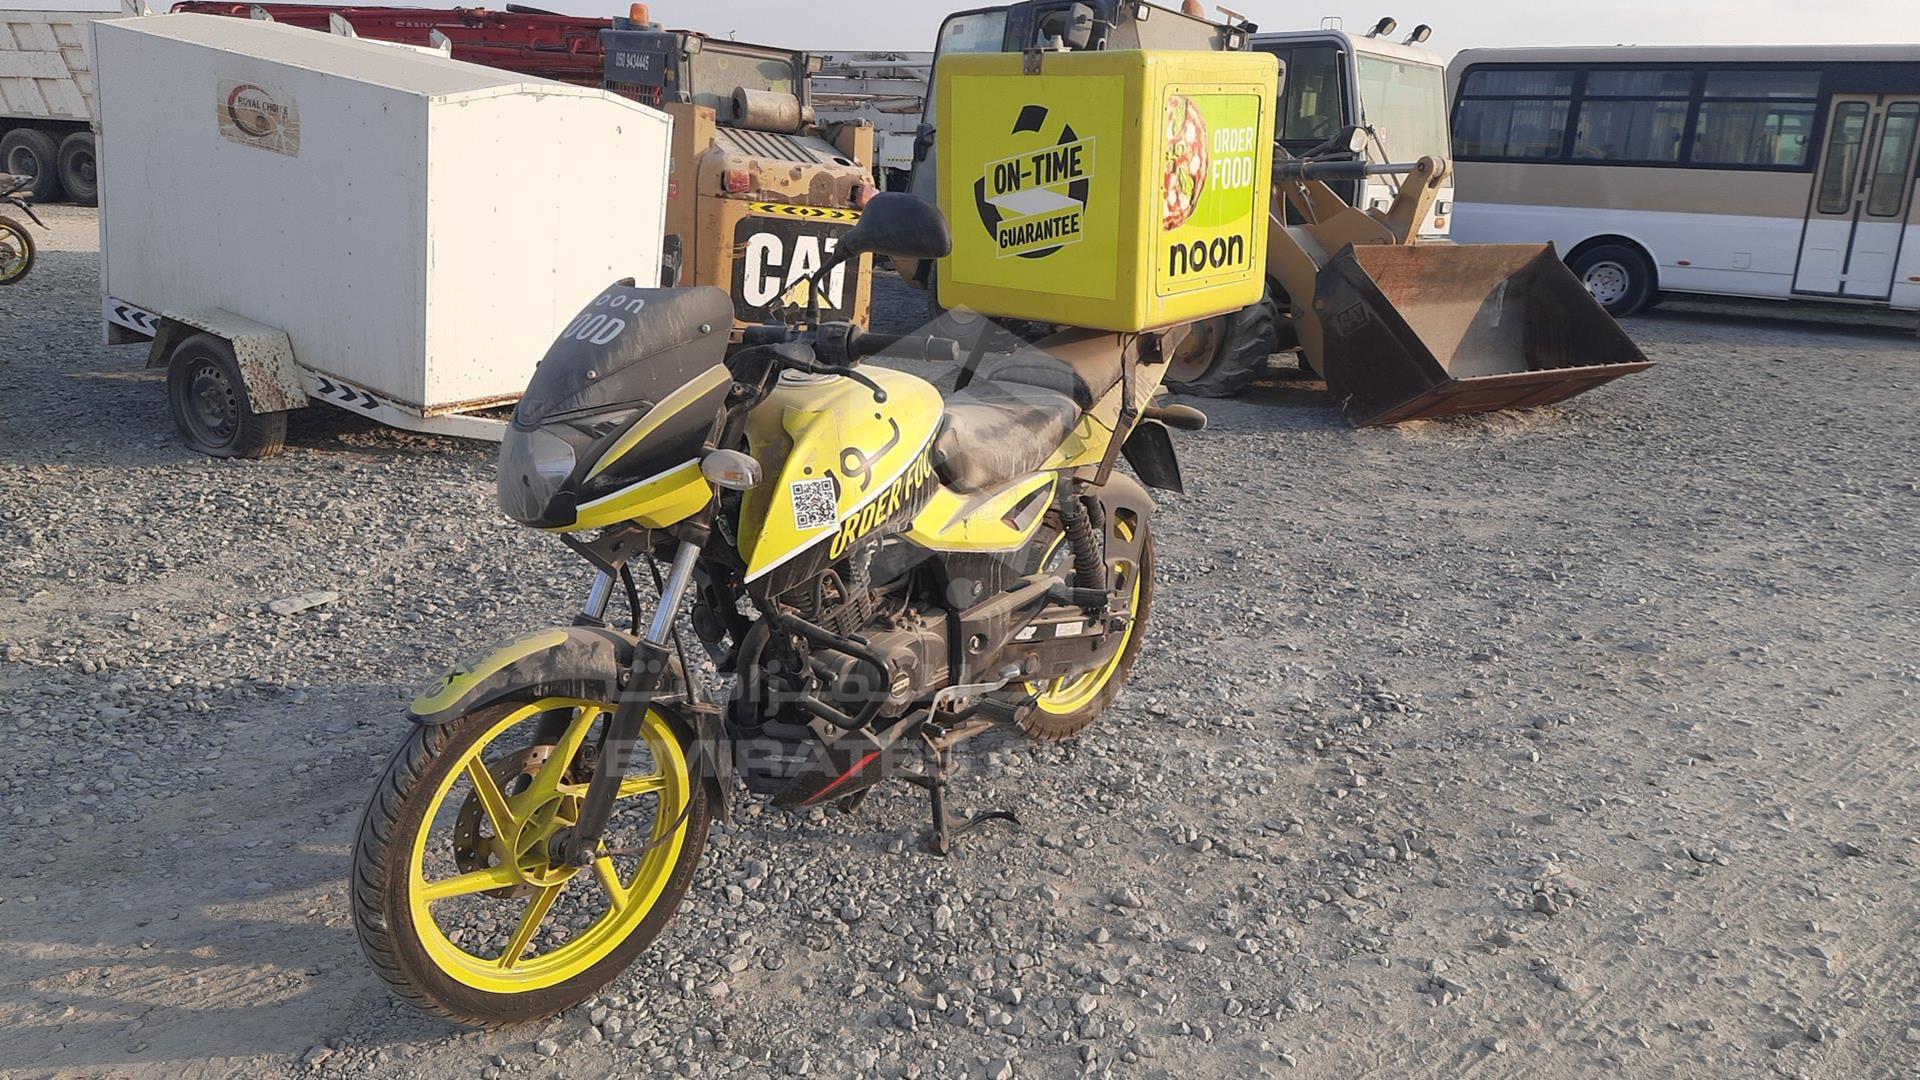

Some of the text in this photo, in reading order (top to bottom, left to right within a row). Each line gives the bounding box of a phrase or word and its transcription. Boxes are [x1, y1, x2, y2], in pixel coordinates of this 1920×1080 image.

[1213, 126, 1254, 153] ORDER
[993, 144, 1083, 195] ON-TIME
[1211, 156, 1252, 192] FOOD
[999, 212, 1080, 249] GUARANTEE
[1168, 233, 1244, 277] noon
[595, 293, 646, 315] oon
[562, 312, 626, 345] OOD
[829, 432, 938, 561] ORDER FOO
